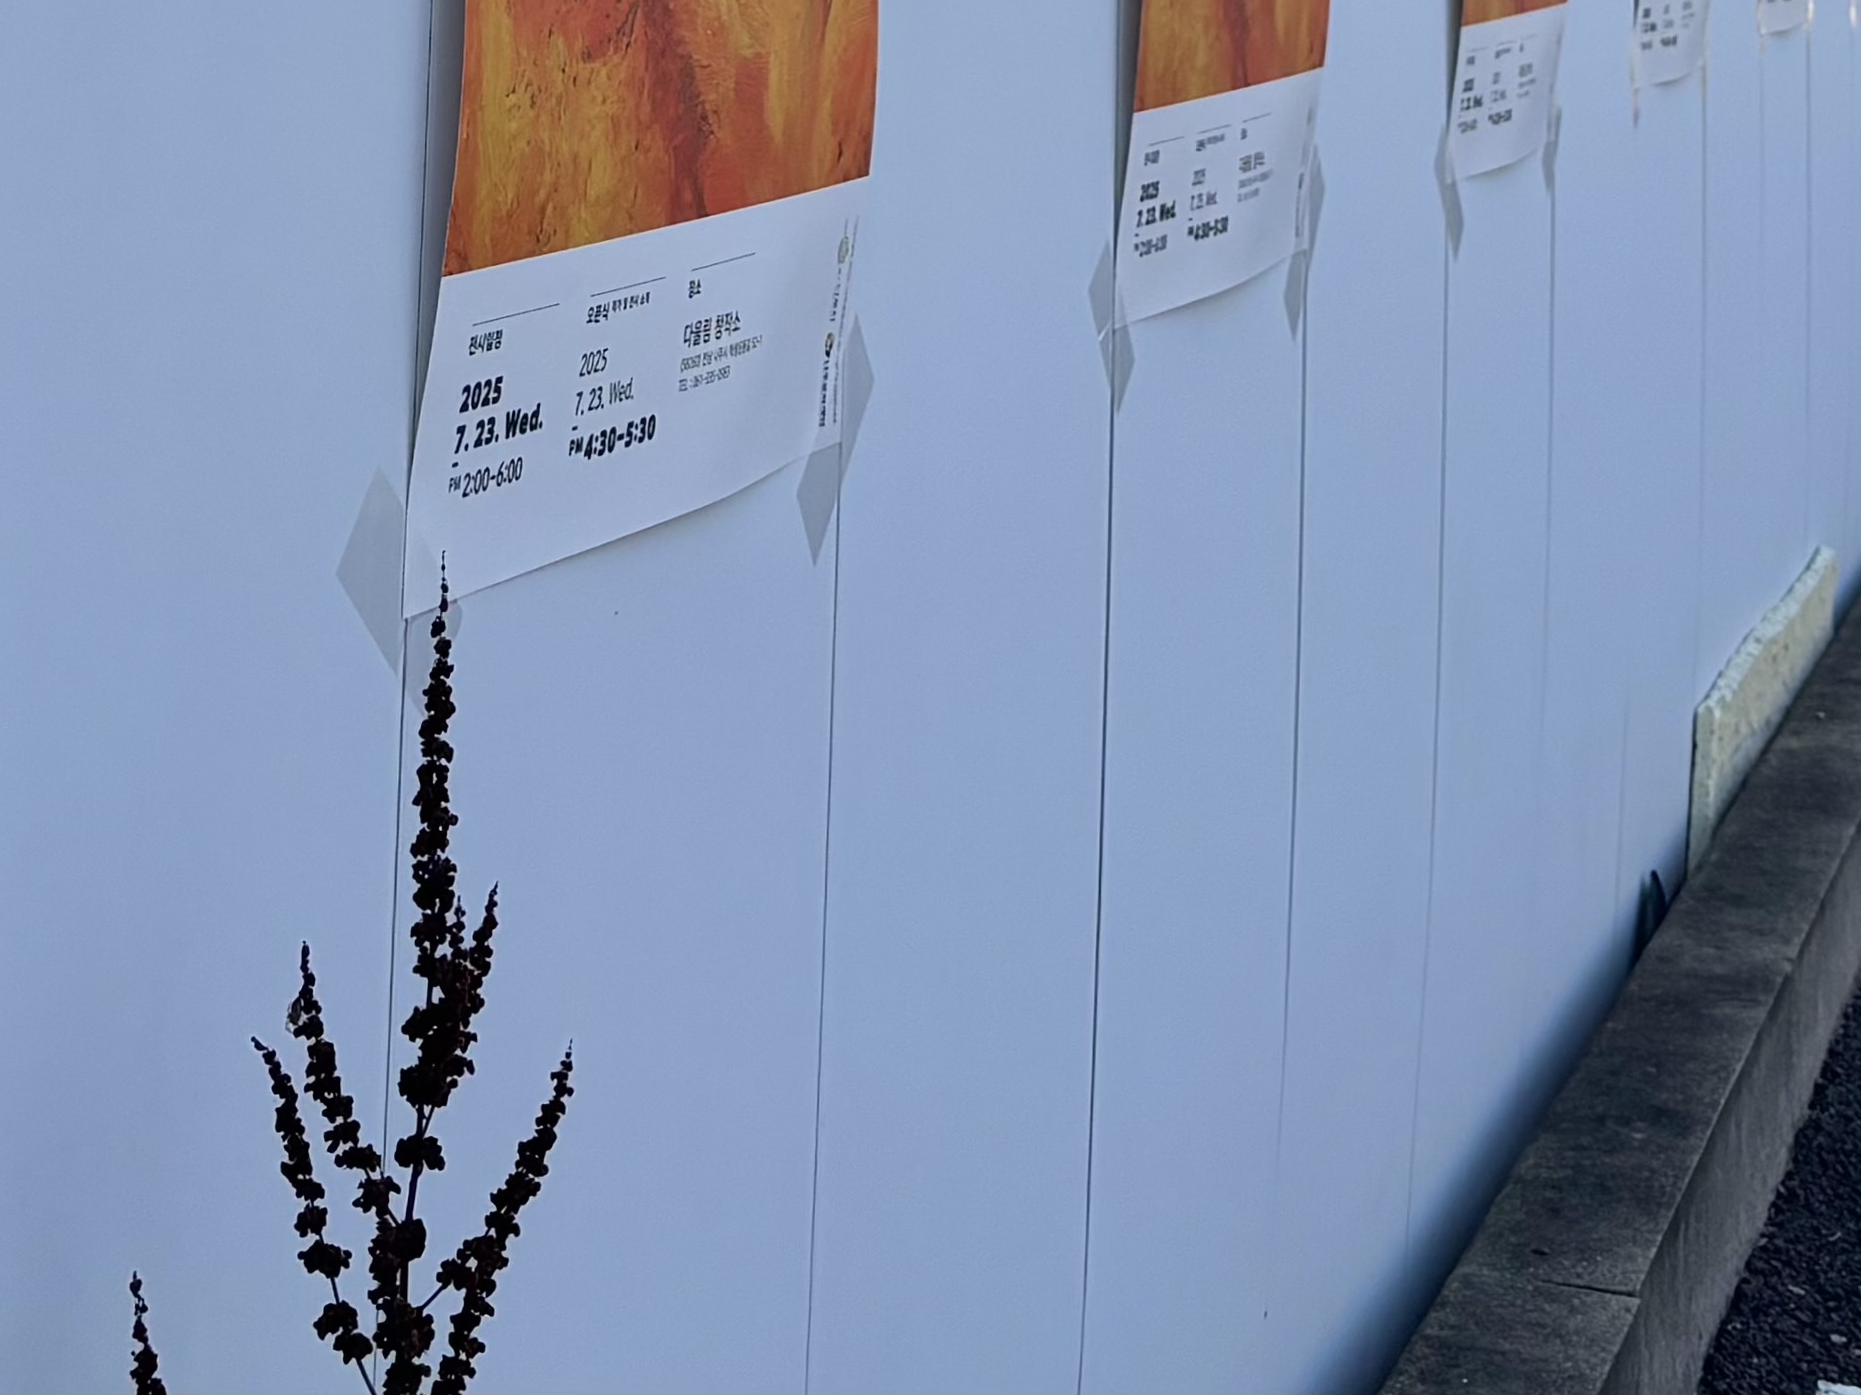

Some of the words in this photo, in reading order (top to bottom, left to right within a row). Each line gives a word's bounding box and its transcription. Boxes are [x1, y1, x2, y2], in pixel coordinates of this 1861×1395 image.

[578, 348, 608, 377] 2025
[459, 375, 503, 413] 2025
[609, 377, 634, 406] Wed.
[454, 425, 469, 454] 7.
[473, 416, 499, 449] 23.
[505, 402, 543, 440] Wed.
